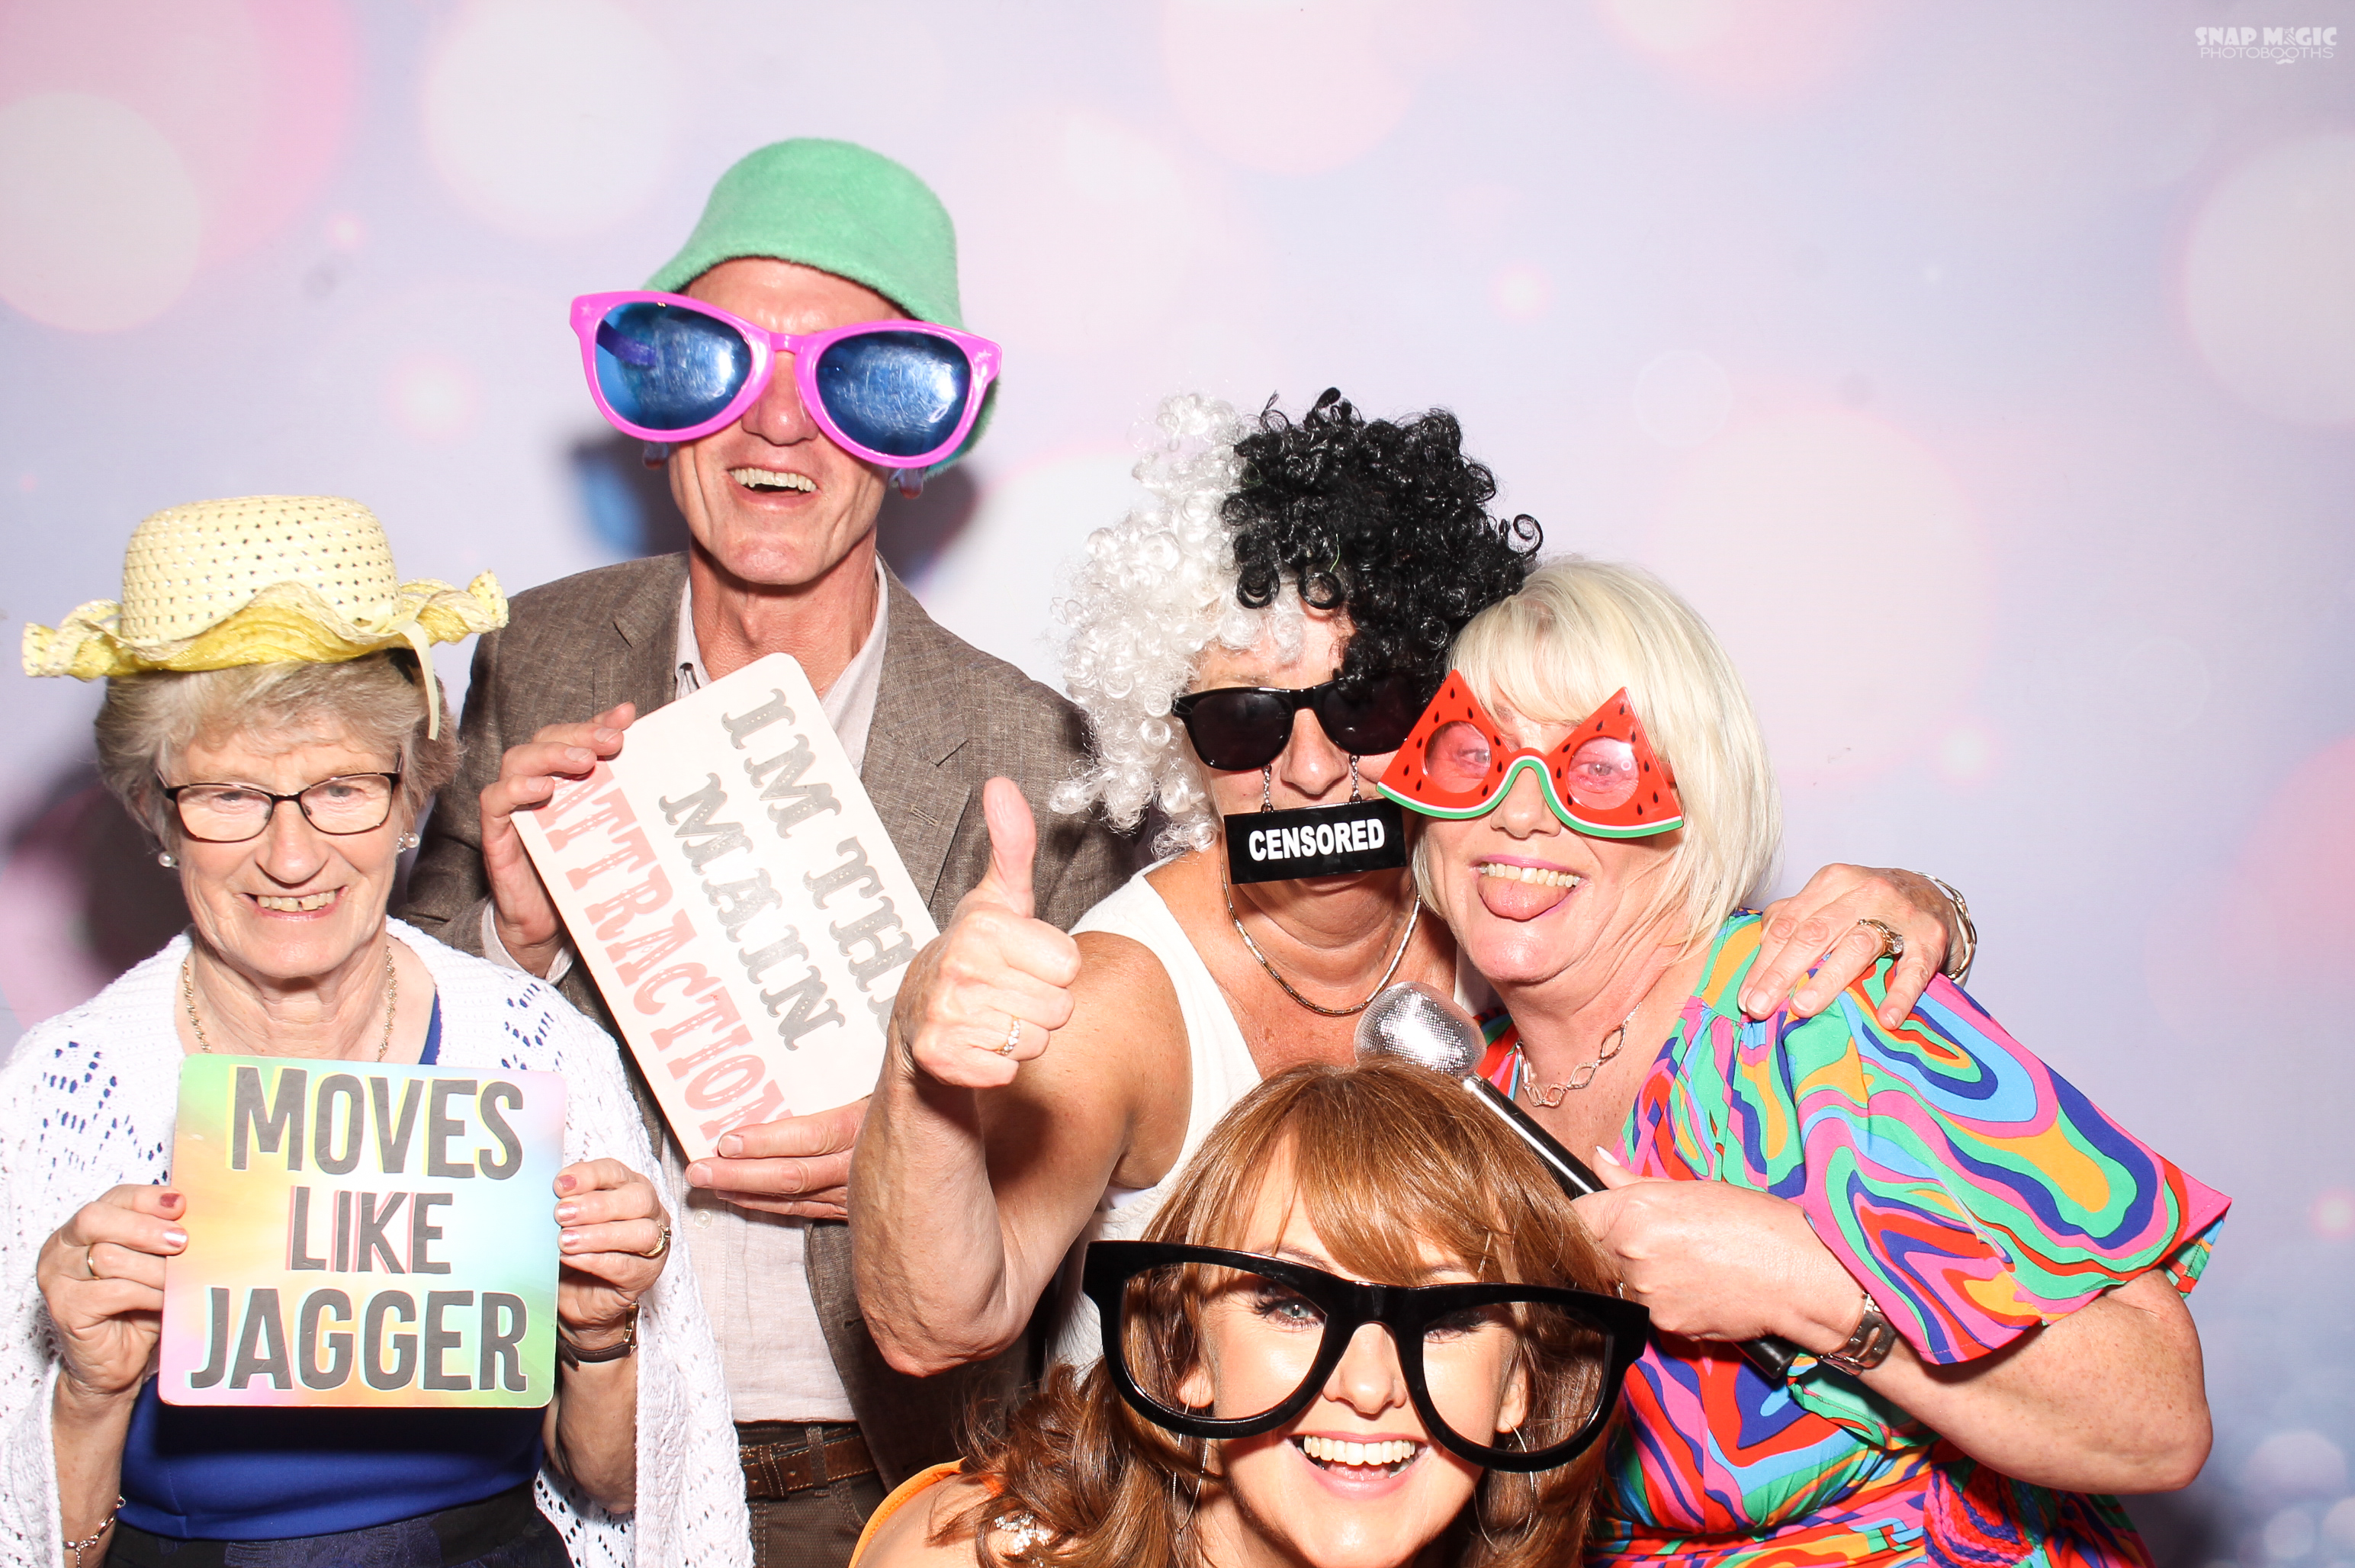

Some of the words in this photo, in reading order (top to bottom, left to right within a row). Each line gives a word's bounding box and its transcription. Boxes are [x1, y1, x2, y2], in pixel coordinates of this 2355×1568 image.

[721, 688, 842, 839] IM
[802, 835, 917, 1038] TH
[1248, 818, 1386, 862] CENSORED
[658, 772, 846, 1052] MAIN
[227, 1065, 524, 1180] MOVES
[286, 1185, 454, 1274] LIKE
[186, 1285, 529, 1392] JAGGER
